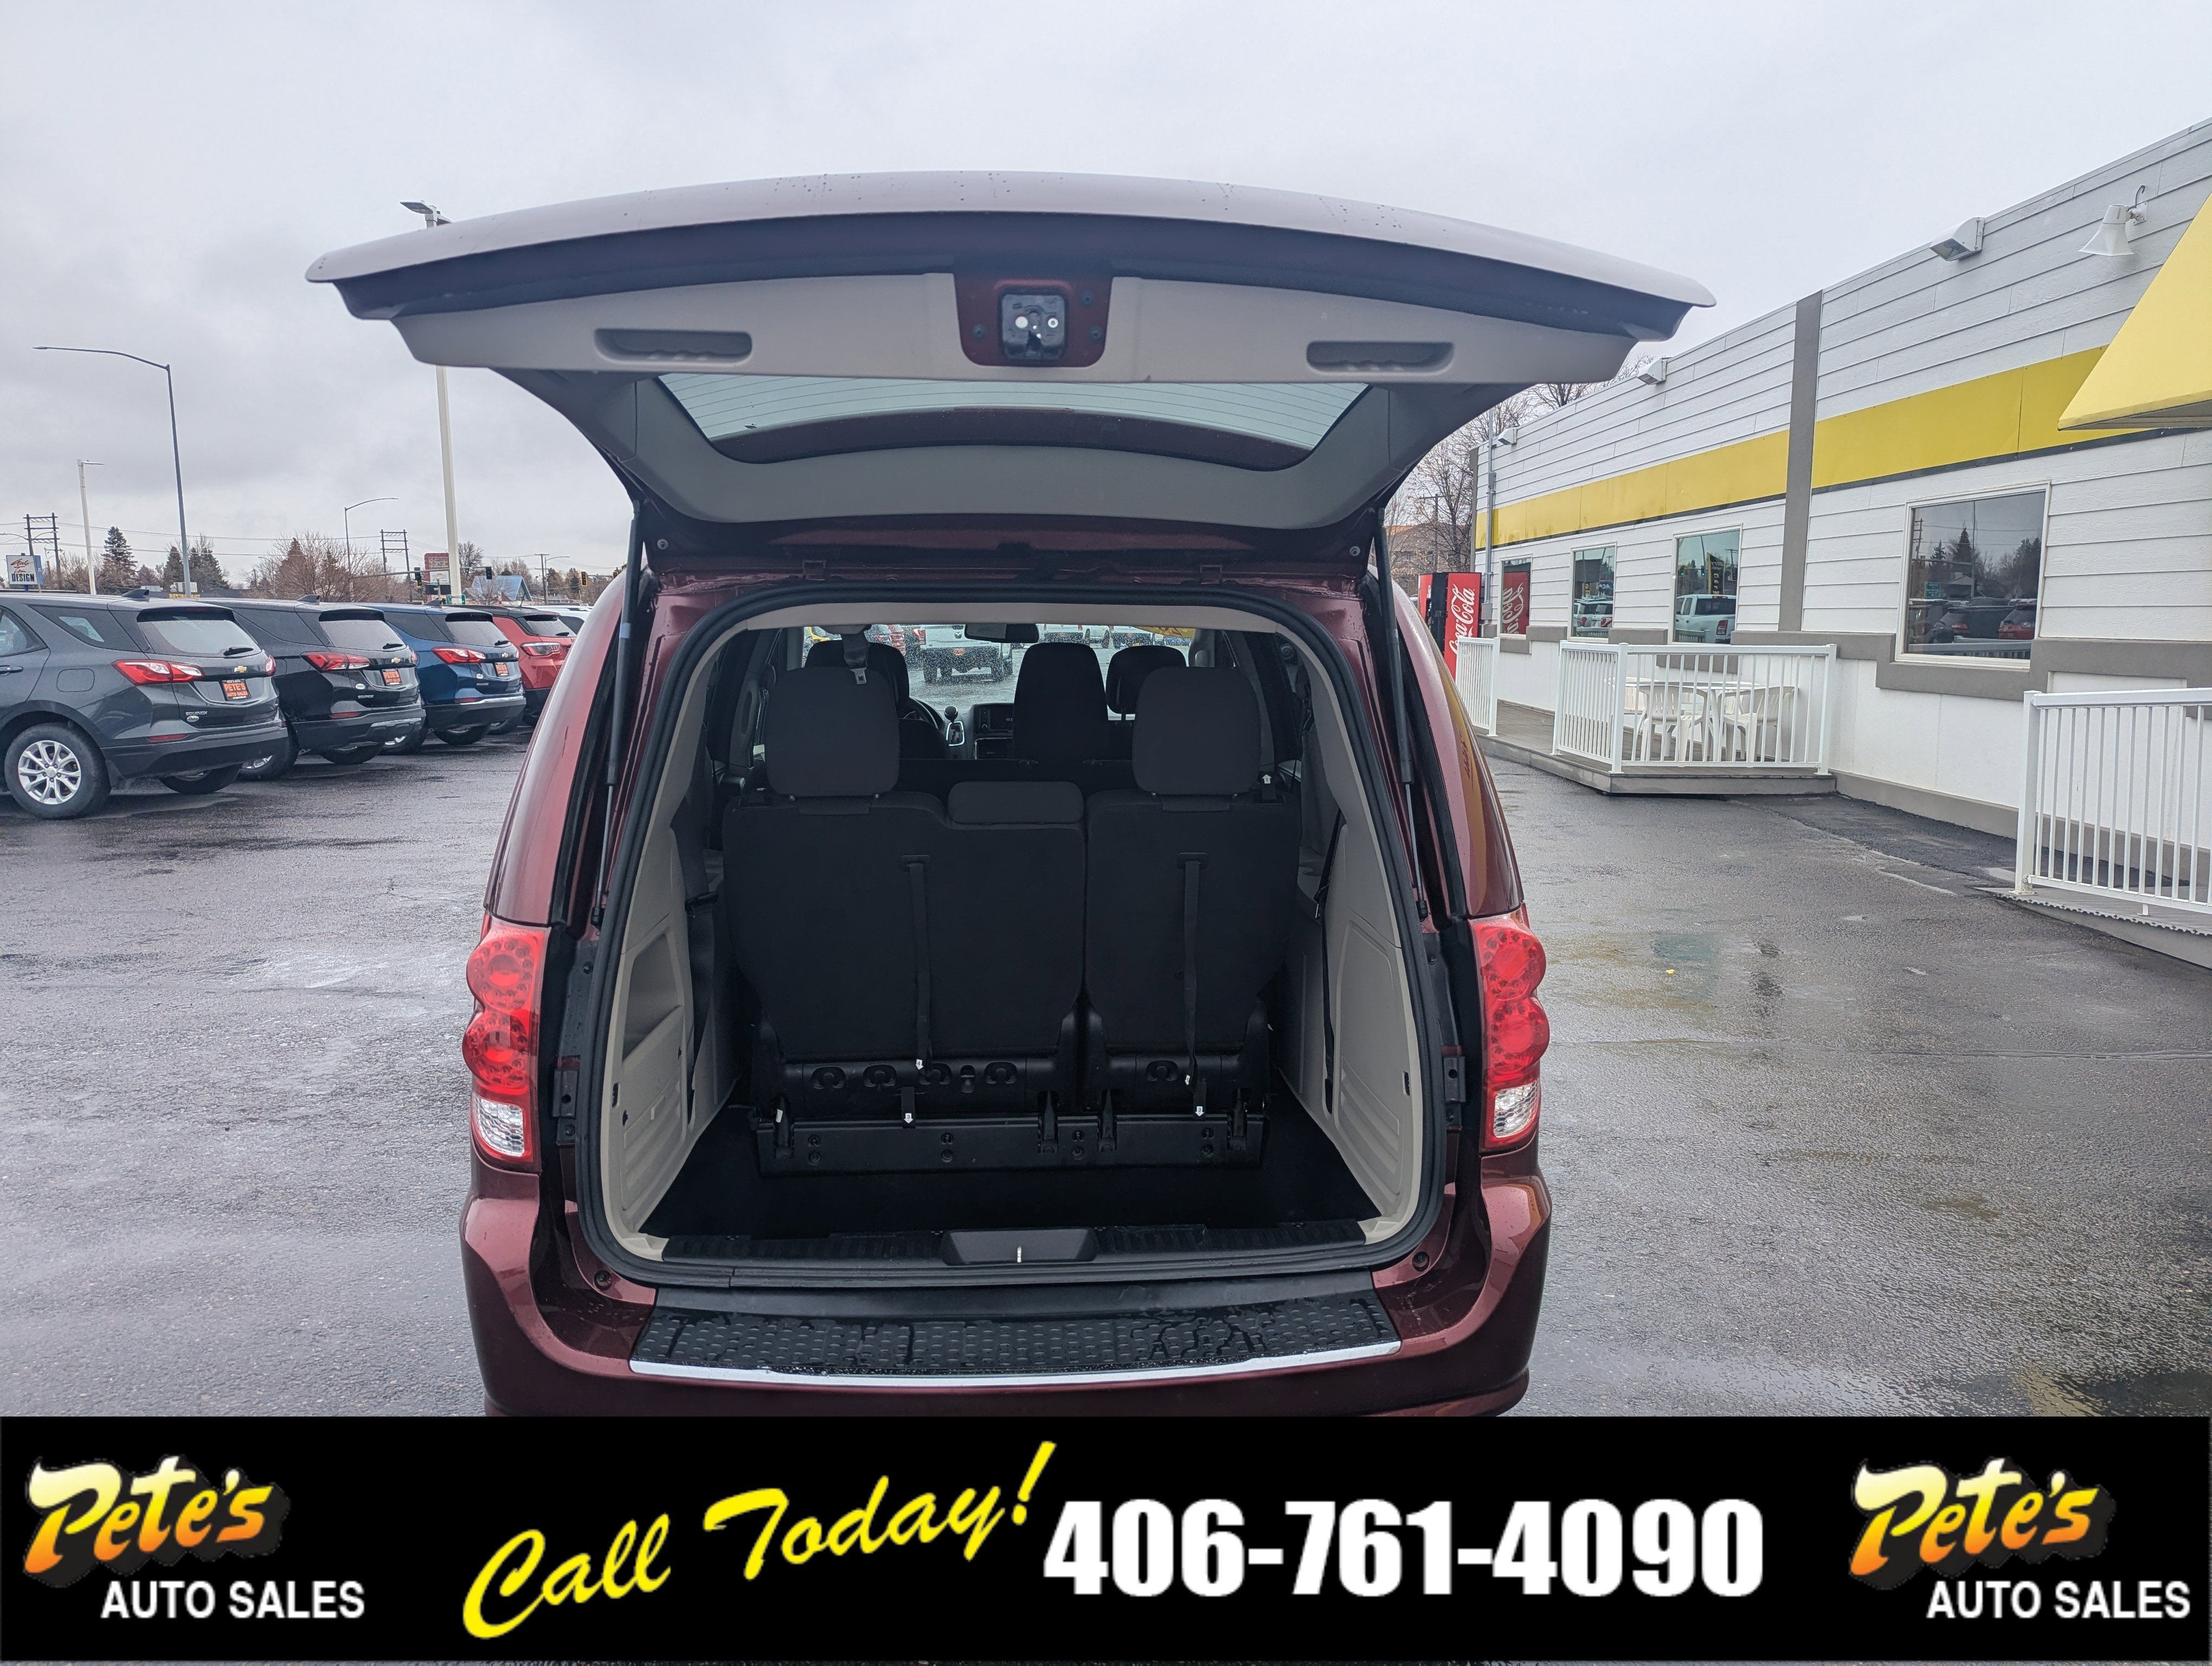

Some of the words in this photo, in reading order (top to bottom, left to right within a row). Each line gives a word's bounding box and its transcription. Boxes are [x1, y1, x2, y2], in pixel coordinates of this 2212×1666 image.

[11, 574, 35, 582] DESIGN
[1449, 583, 1475, 655] Ca-Cola
[223, 683, 246, 691] PETE'S
